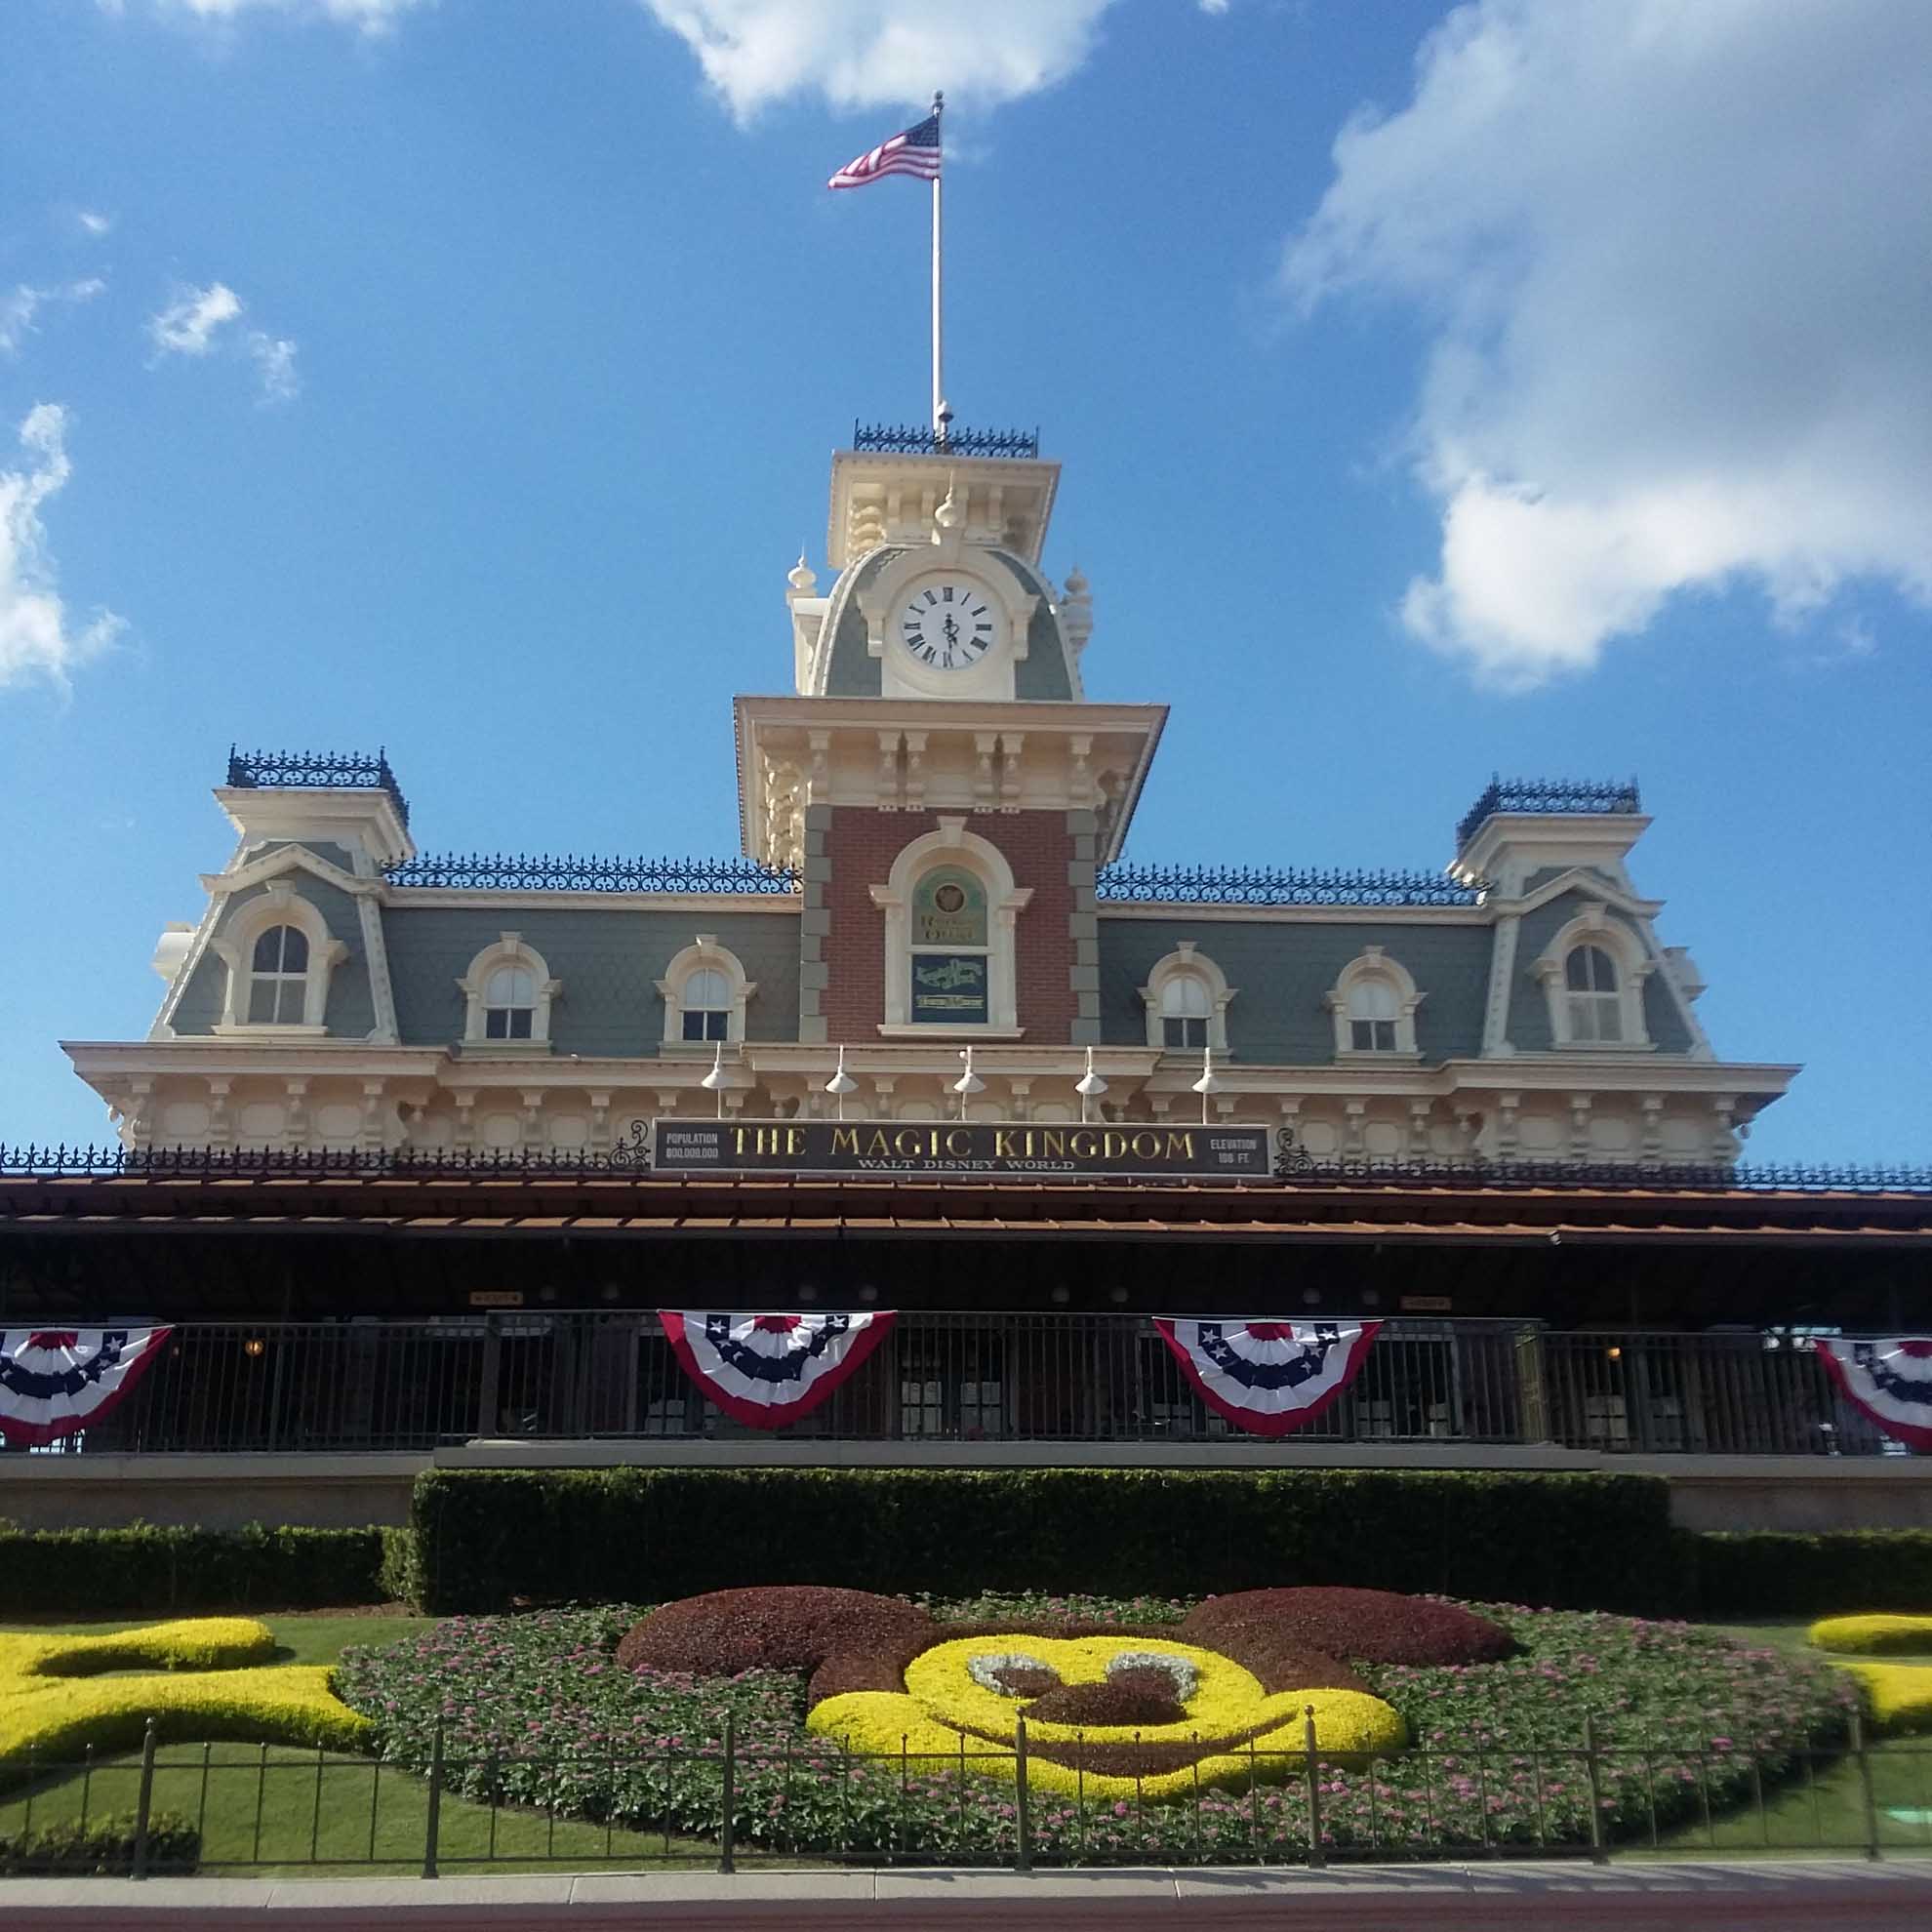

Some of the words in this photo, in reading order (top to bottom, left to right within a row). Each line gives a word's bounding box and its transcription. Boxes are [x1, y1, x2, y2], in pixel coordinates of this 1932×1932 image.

[666, 1132, 718, 1145] POPULATION
[730, 1127, 807, 1155] THE
[827, 1127, 972, 1158] MAGIC
[993, 1130, 1195, 1160] KINGDOM
[1210, 1139, 1257, 1149] ELEVATION
[859, 1159, 916, 1169] WALT
[923, 1159, 996, 1170] DISNEY
[1006, 1160, 1075, 1170] WORLD
